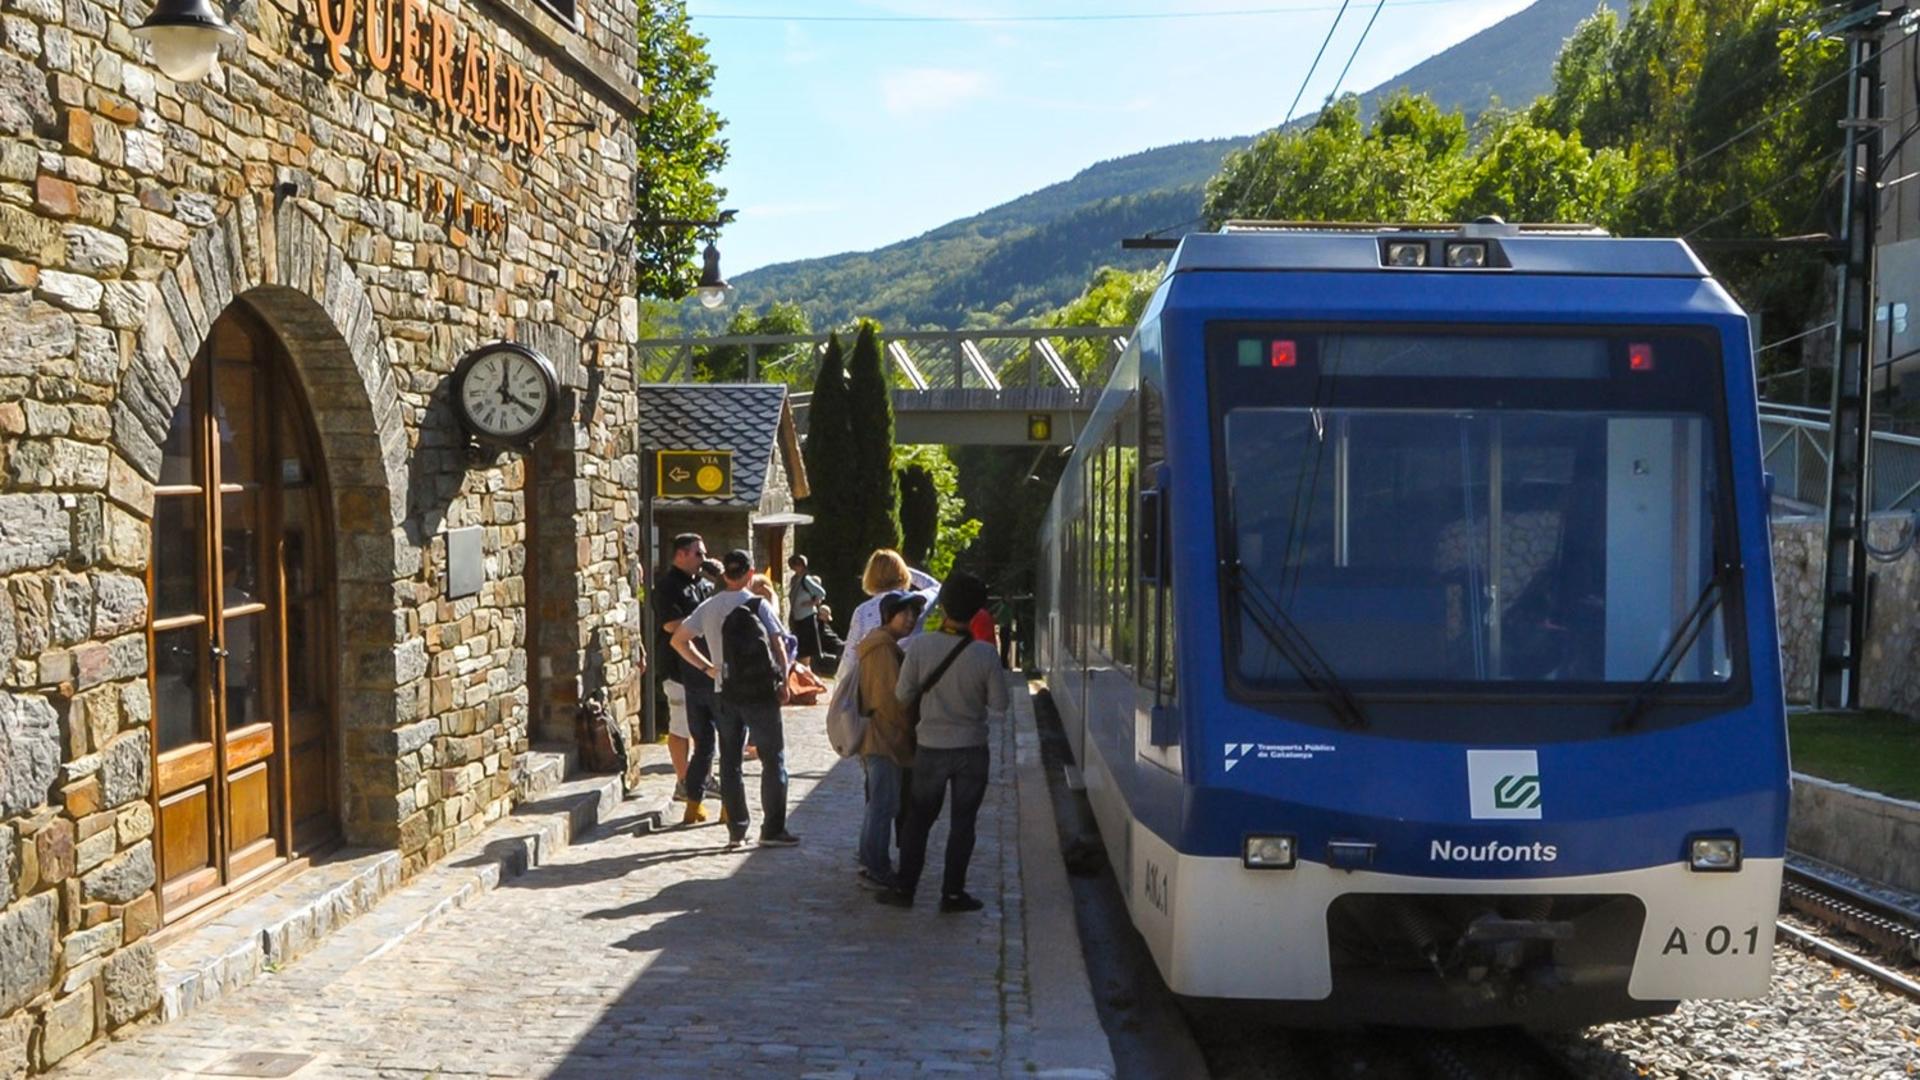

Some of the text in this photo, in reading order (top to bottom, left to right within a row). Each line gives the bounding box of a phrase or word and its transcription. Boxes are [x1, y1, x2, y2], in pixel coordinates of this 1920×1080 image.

[318, 0, 546, 155] QUERALBS
[700, 456, 719, 464] VIA
[1430, 840, 1558, 862] Noufonts
[1661, 925, 1759, 956] A 0.1
